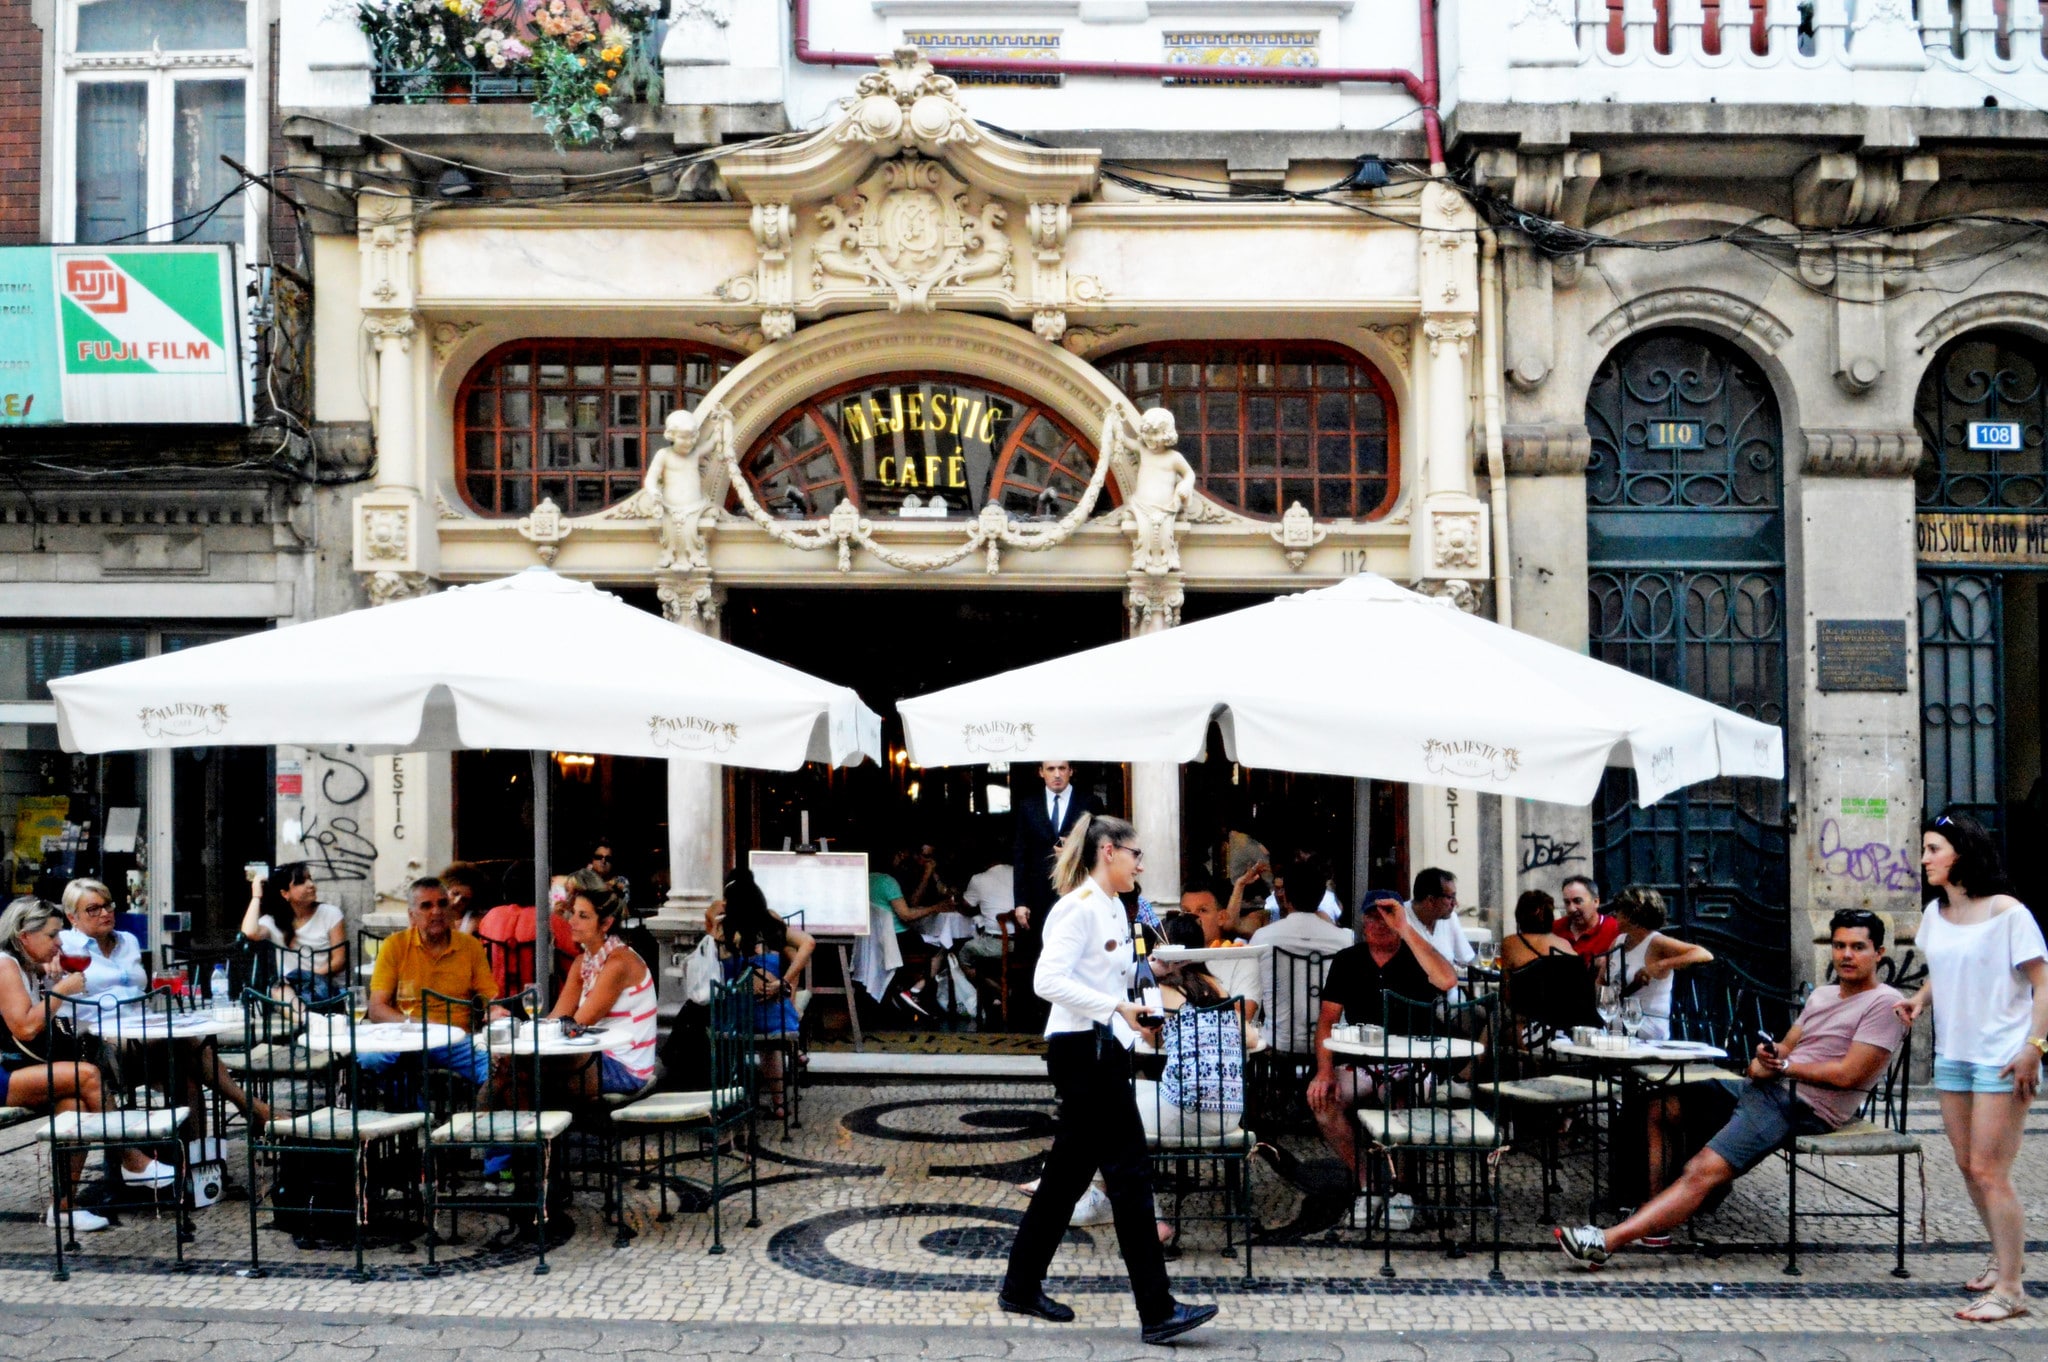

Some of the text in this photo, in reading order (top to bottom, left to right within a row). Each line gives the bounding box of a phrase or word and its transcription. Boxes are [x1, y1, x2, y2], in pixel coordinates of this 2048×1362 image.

[77, 341, 210, 361] FUJI FILM
[843, 392, 1003, 444] MAJESTIC
[1660, 423, 1692, 443] 110
[1980, 426, 2010, 443] 108
[879, 446, 967, 488] CAFÉ
[1917, 521, 2018, 553] ONSULTORIO
[1342, 550, 1368, 573] 112
[155, 703, 209, 720] MAJESTIC
[664, 716, 720, 735] MAJESTIC
[976, 720, 1019, 736] MAJESTIC
[1441, 740, 1499, 761] MAJESTIC
[393, 752, 404, 840] ESTIC
[1446, 787, 1459, 854] STIC
